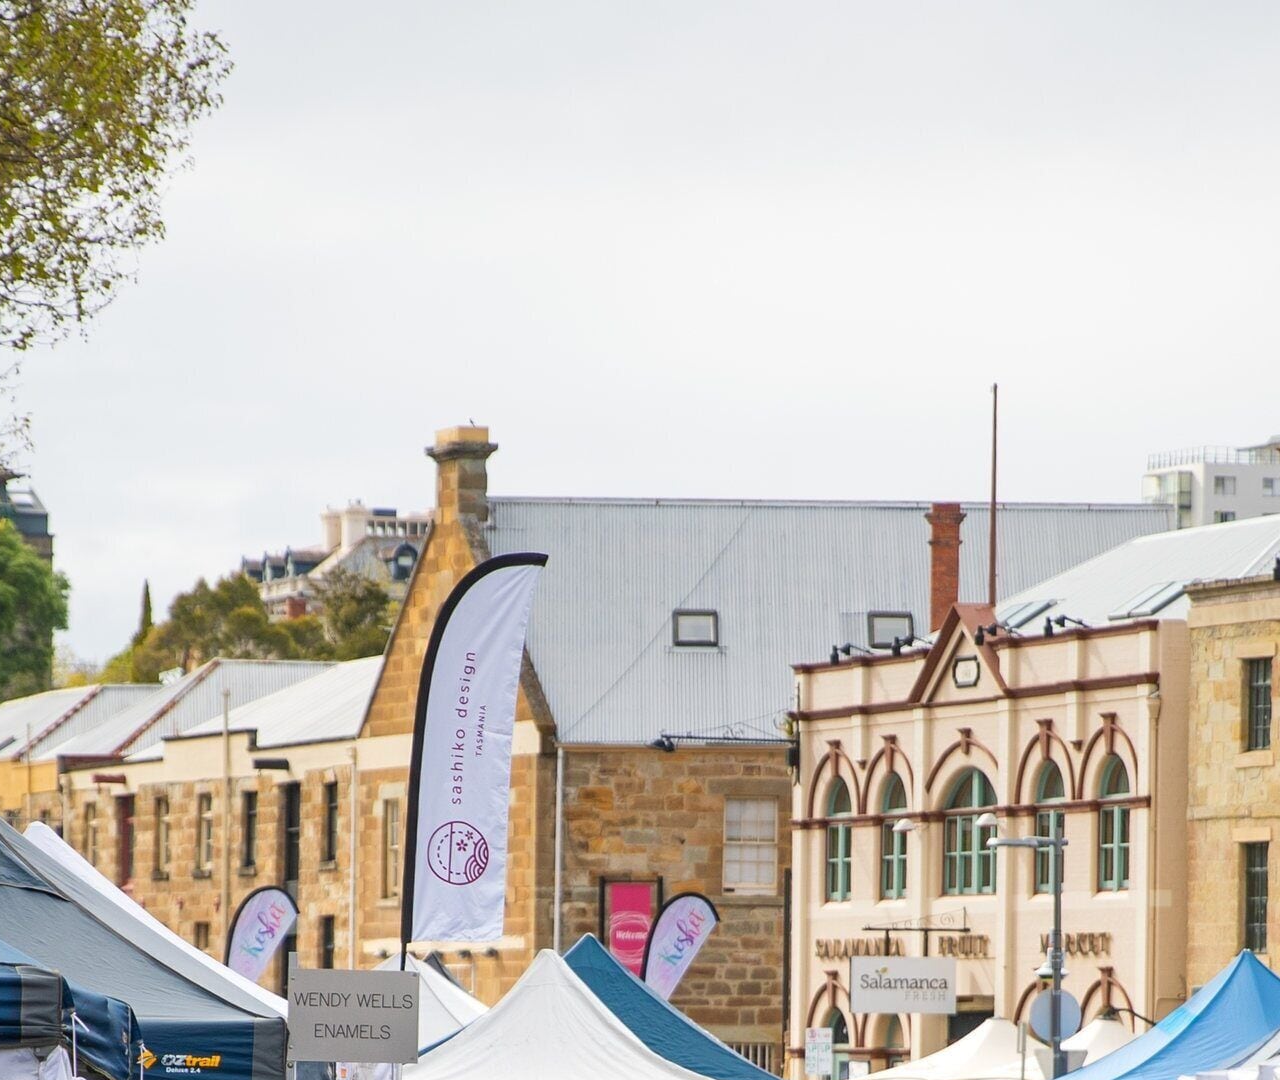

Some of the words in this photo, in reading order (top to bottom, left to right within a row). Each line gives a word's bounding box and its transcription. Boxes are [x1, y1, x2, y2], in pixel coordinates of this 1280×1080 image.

[457, 650, 477, 718] design
[474, 704, 488, 757] TASMANIA
[450, 727, 467, 806] sashiko
[240, 901, 287, 957] Keshet
[659, 908, 705, 967] Keshet
[815, 936, 906, 961] SALAMANA
[1039, 932, 1112, 957] MRKET
[293, 991, 351, 1008] WENDY
[356, 993, 413, 1009] WELLS
[860, 973, 948, 990] Salamanca
[314, 1023, 391, 1039] ENAMELS
[160, 1053, 221, 1068] OZtrail
